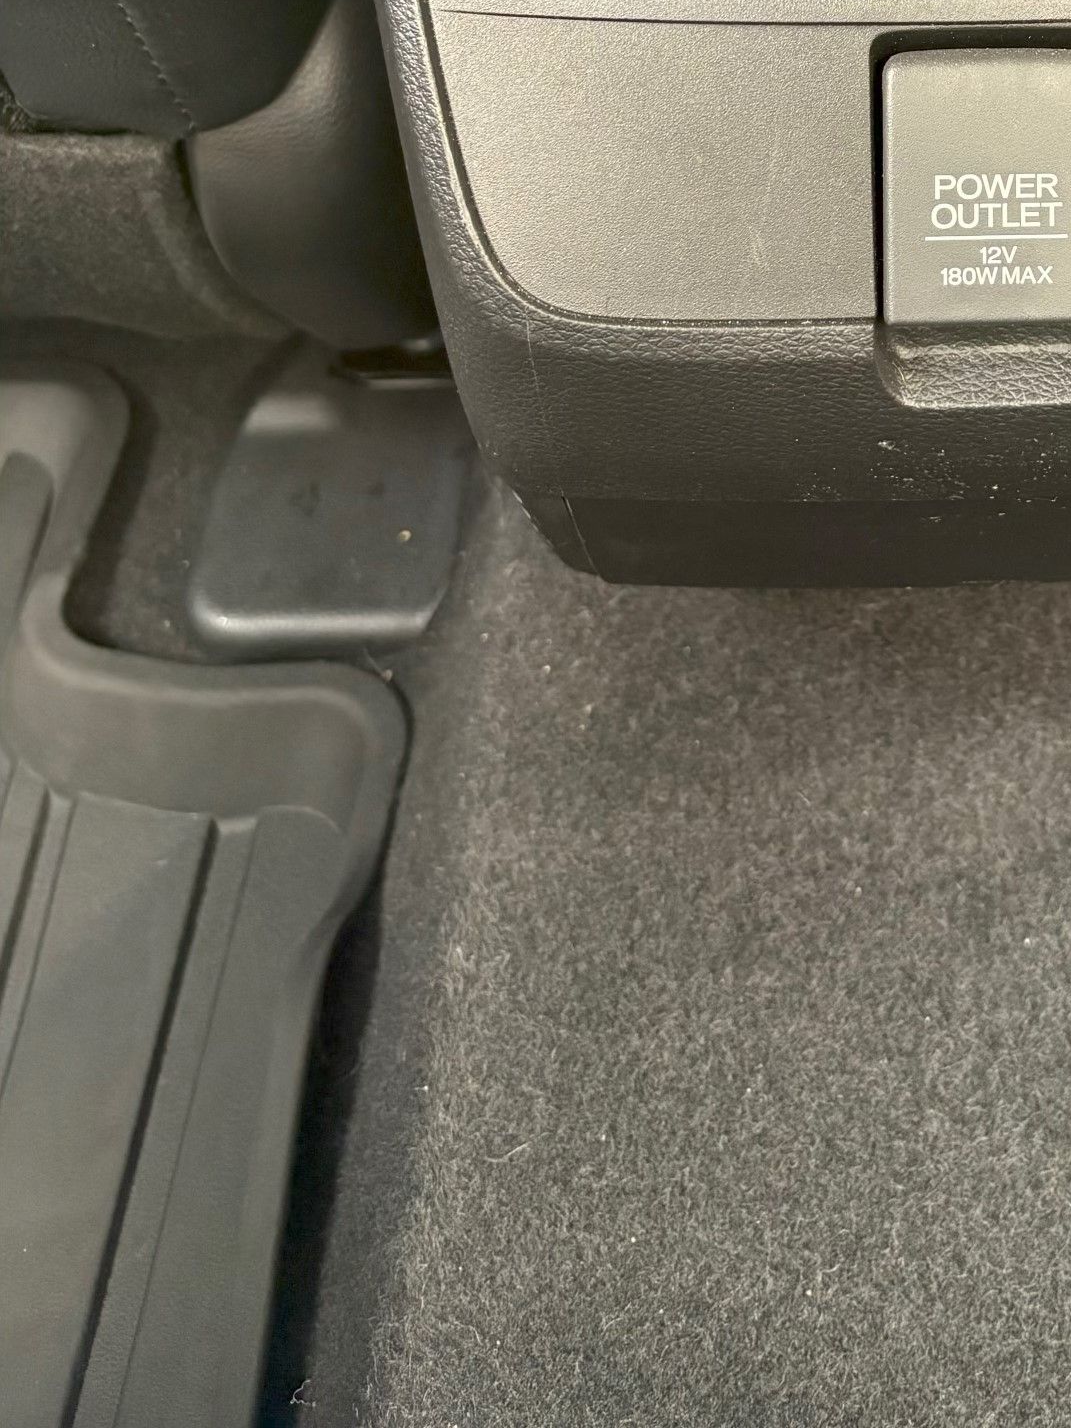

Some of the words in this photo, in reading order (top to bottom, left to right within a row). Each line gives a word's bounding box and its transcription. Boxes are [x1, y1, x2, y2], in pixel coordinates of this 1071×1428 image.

[934, 173, 1059, 200] POWER
[931, 201, 1063, 229] OUTLET
[979, 245, 1018, 264] 12V
[940, 266, 998, 286] 180W
[1001, 265, 1054, 285] MAX
